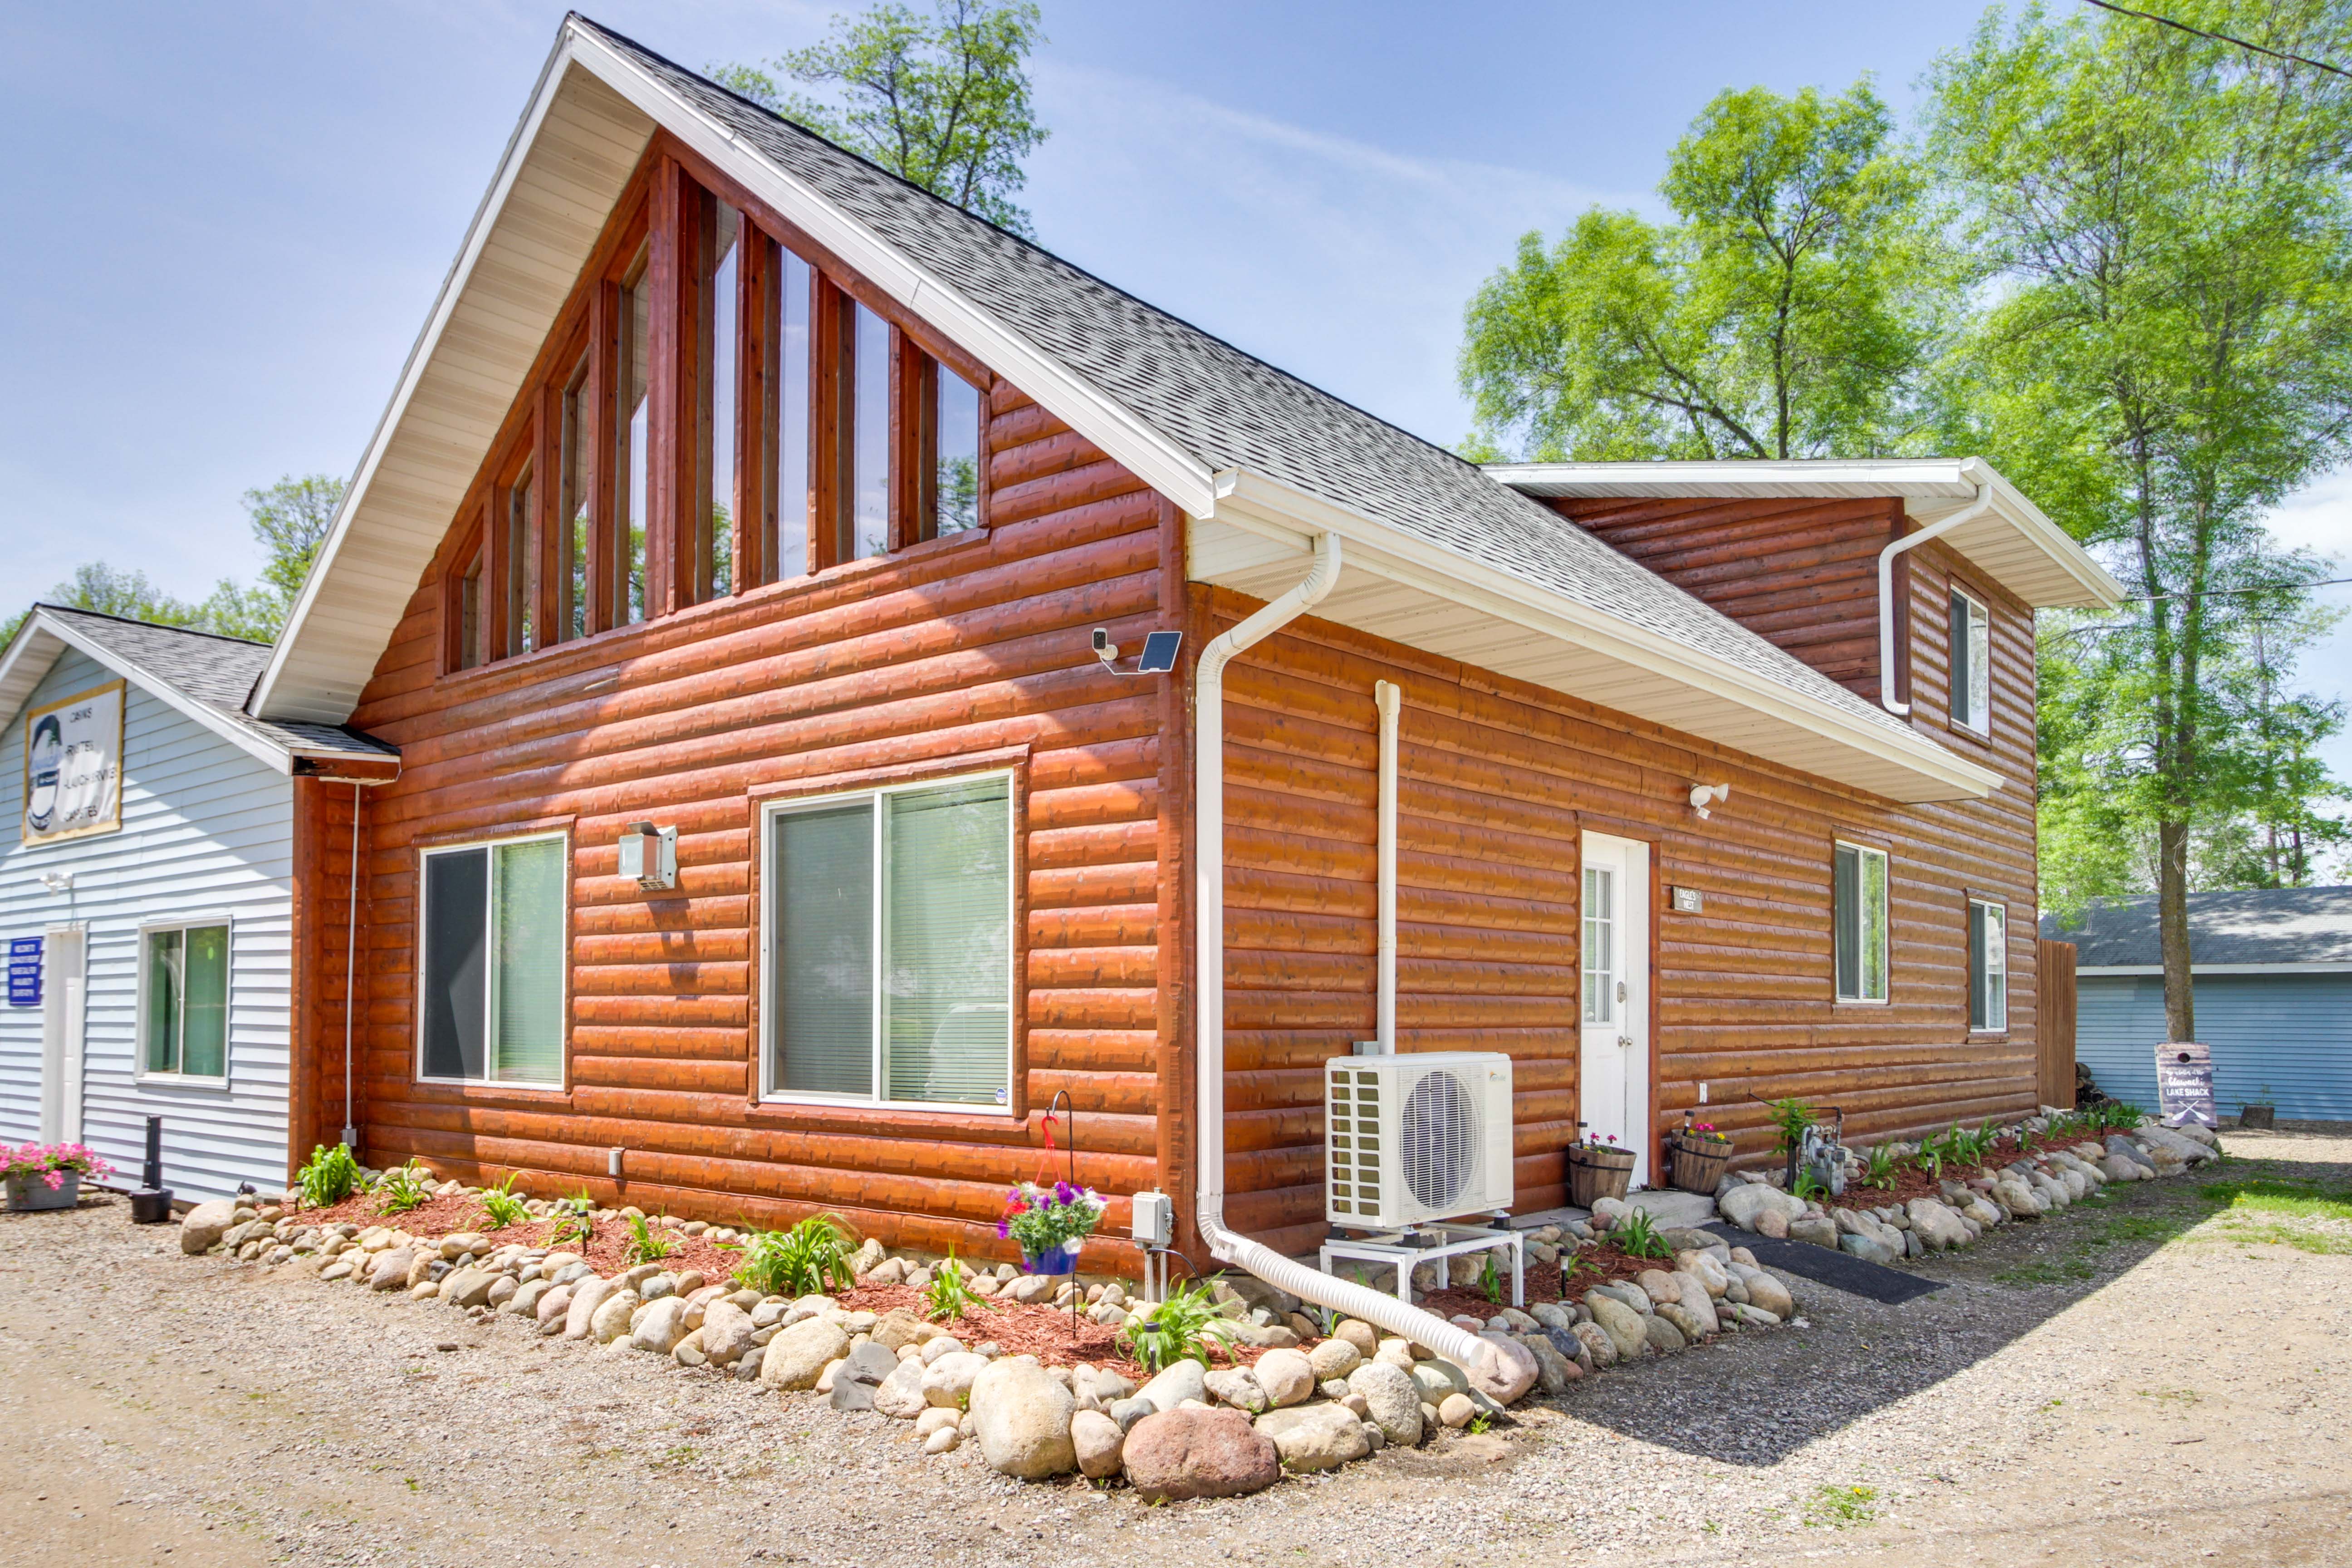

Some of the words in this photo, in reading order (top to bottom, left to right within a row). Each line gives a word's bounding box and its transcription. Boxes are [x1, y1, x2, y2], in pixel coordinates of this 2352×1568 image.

[1684, 899, 1694, 910] NEST
[2166, 1088, 2184, 1096] LAKE
[2184, 1088, 2210, 1096] SHACK
